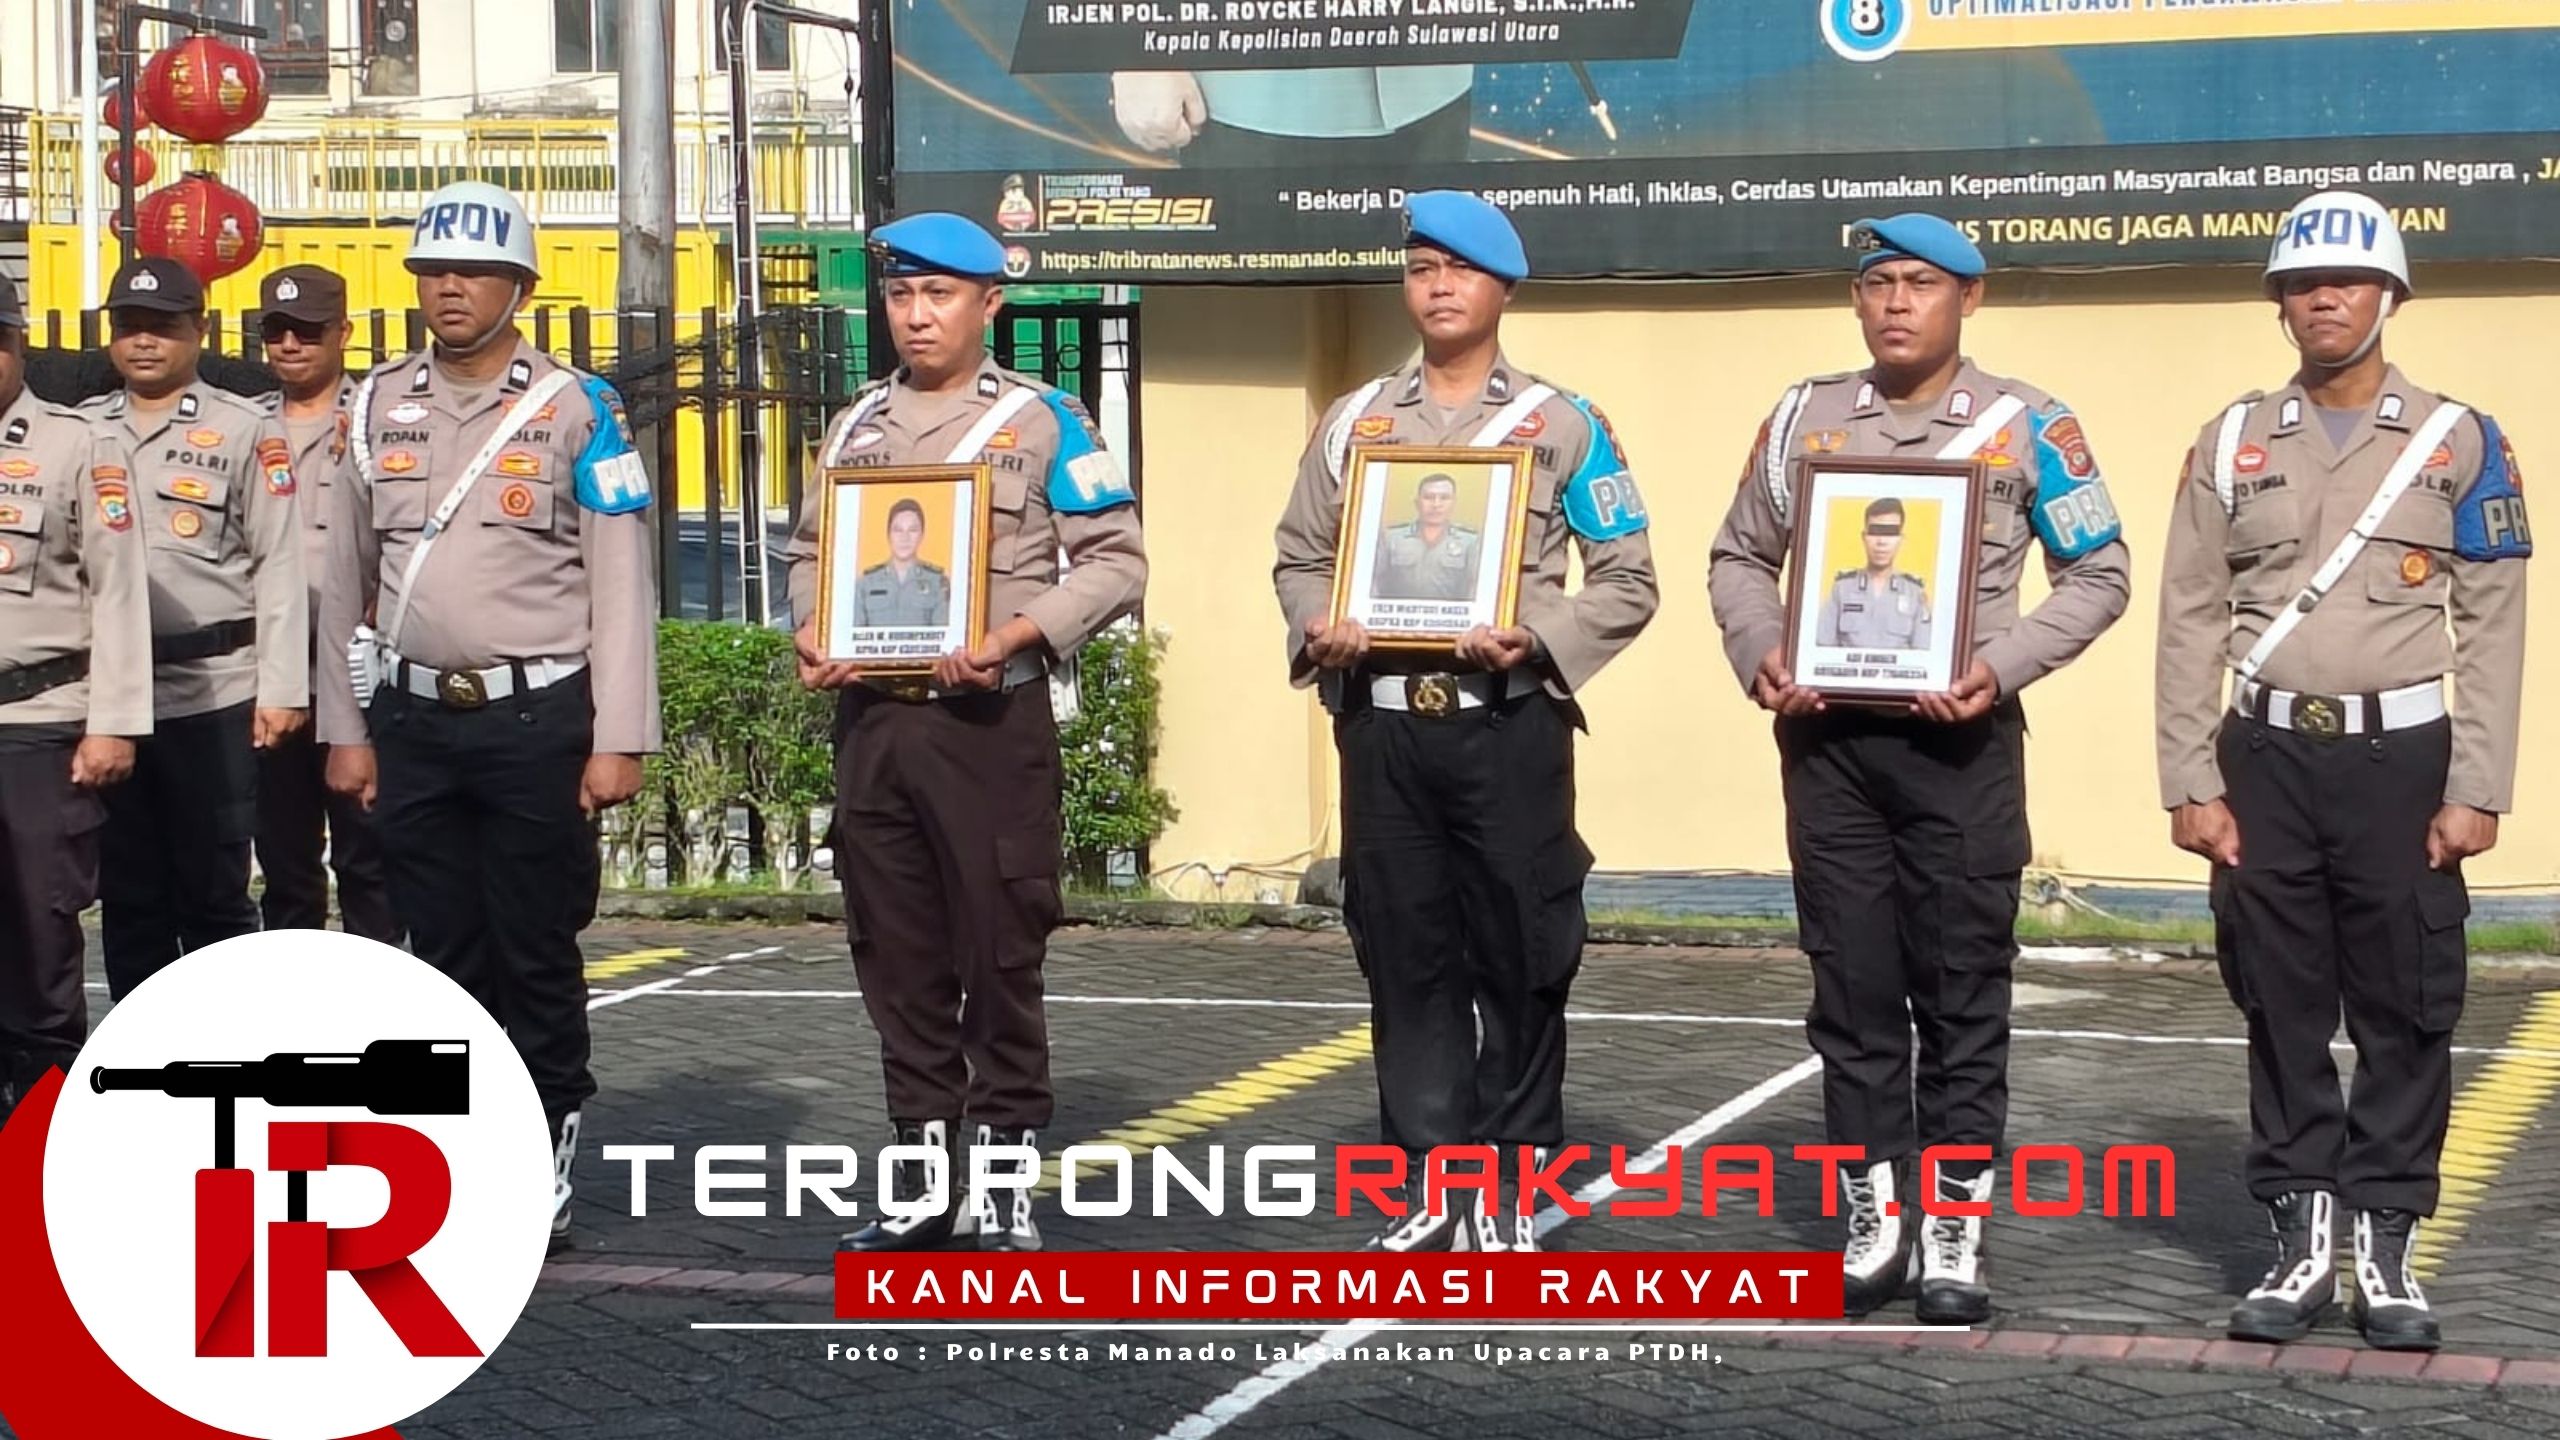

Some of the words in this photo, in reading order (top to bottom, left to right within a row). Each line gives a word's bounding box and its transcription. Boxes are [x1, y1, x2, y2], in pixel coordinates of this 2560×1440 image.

[1048, 4, 1114, 24] IRJEN
[1122, 3, 1173, 22] POL.
[1180, 3, 1218, 21] DR.
[1225, 1, 1317, 21] ROYCKE
[1324, 0, 1402, 19] HARRY
[1850, 0, 1884, 35] 8
[1145, 30, 1211, 54] Kepala
[1218, 28, 1323, 53] Kepolisian
[1330, 24, 1400, 46] Daerah
[1408, 21, 1497, 44] Sulawesi
[1505, 21, 1560, 42] Utara
[1297, 188, 1382, 214] Bekerja
[1483, 183, 1580, 210] sepenuh
[1589, 182, 1641, 207] Hati,
[1648, 179, 1724, 204] Ihklas,
[1731, 178, 1815, 201] Cerdas
[1822, 175, 1942, 199] Utamakan
[1950, 171, 2105, 199] Kepentingan
[2114, 166, 2256, 194] Masyarakat
[2264, 165, 2360, 189] Bangsa
[2367, 160, 2415, 184] dan
[2423, 160, 2515, 185] Negara
[414, 202, 512, 248] PROV
[1987, 216, 2112, 243] TORANG
[2118, 213, 2192, 245] JAGA
[2273, 208, 2378, 260] PROV
[166, 449, 228, 472] POLRI
